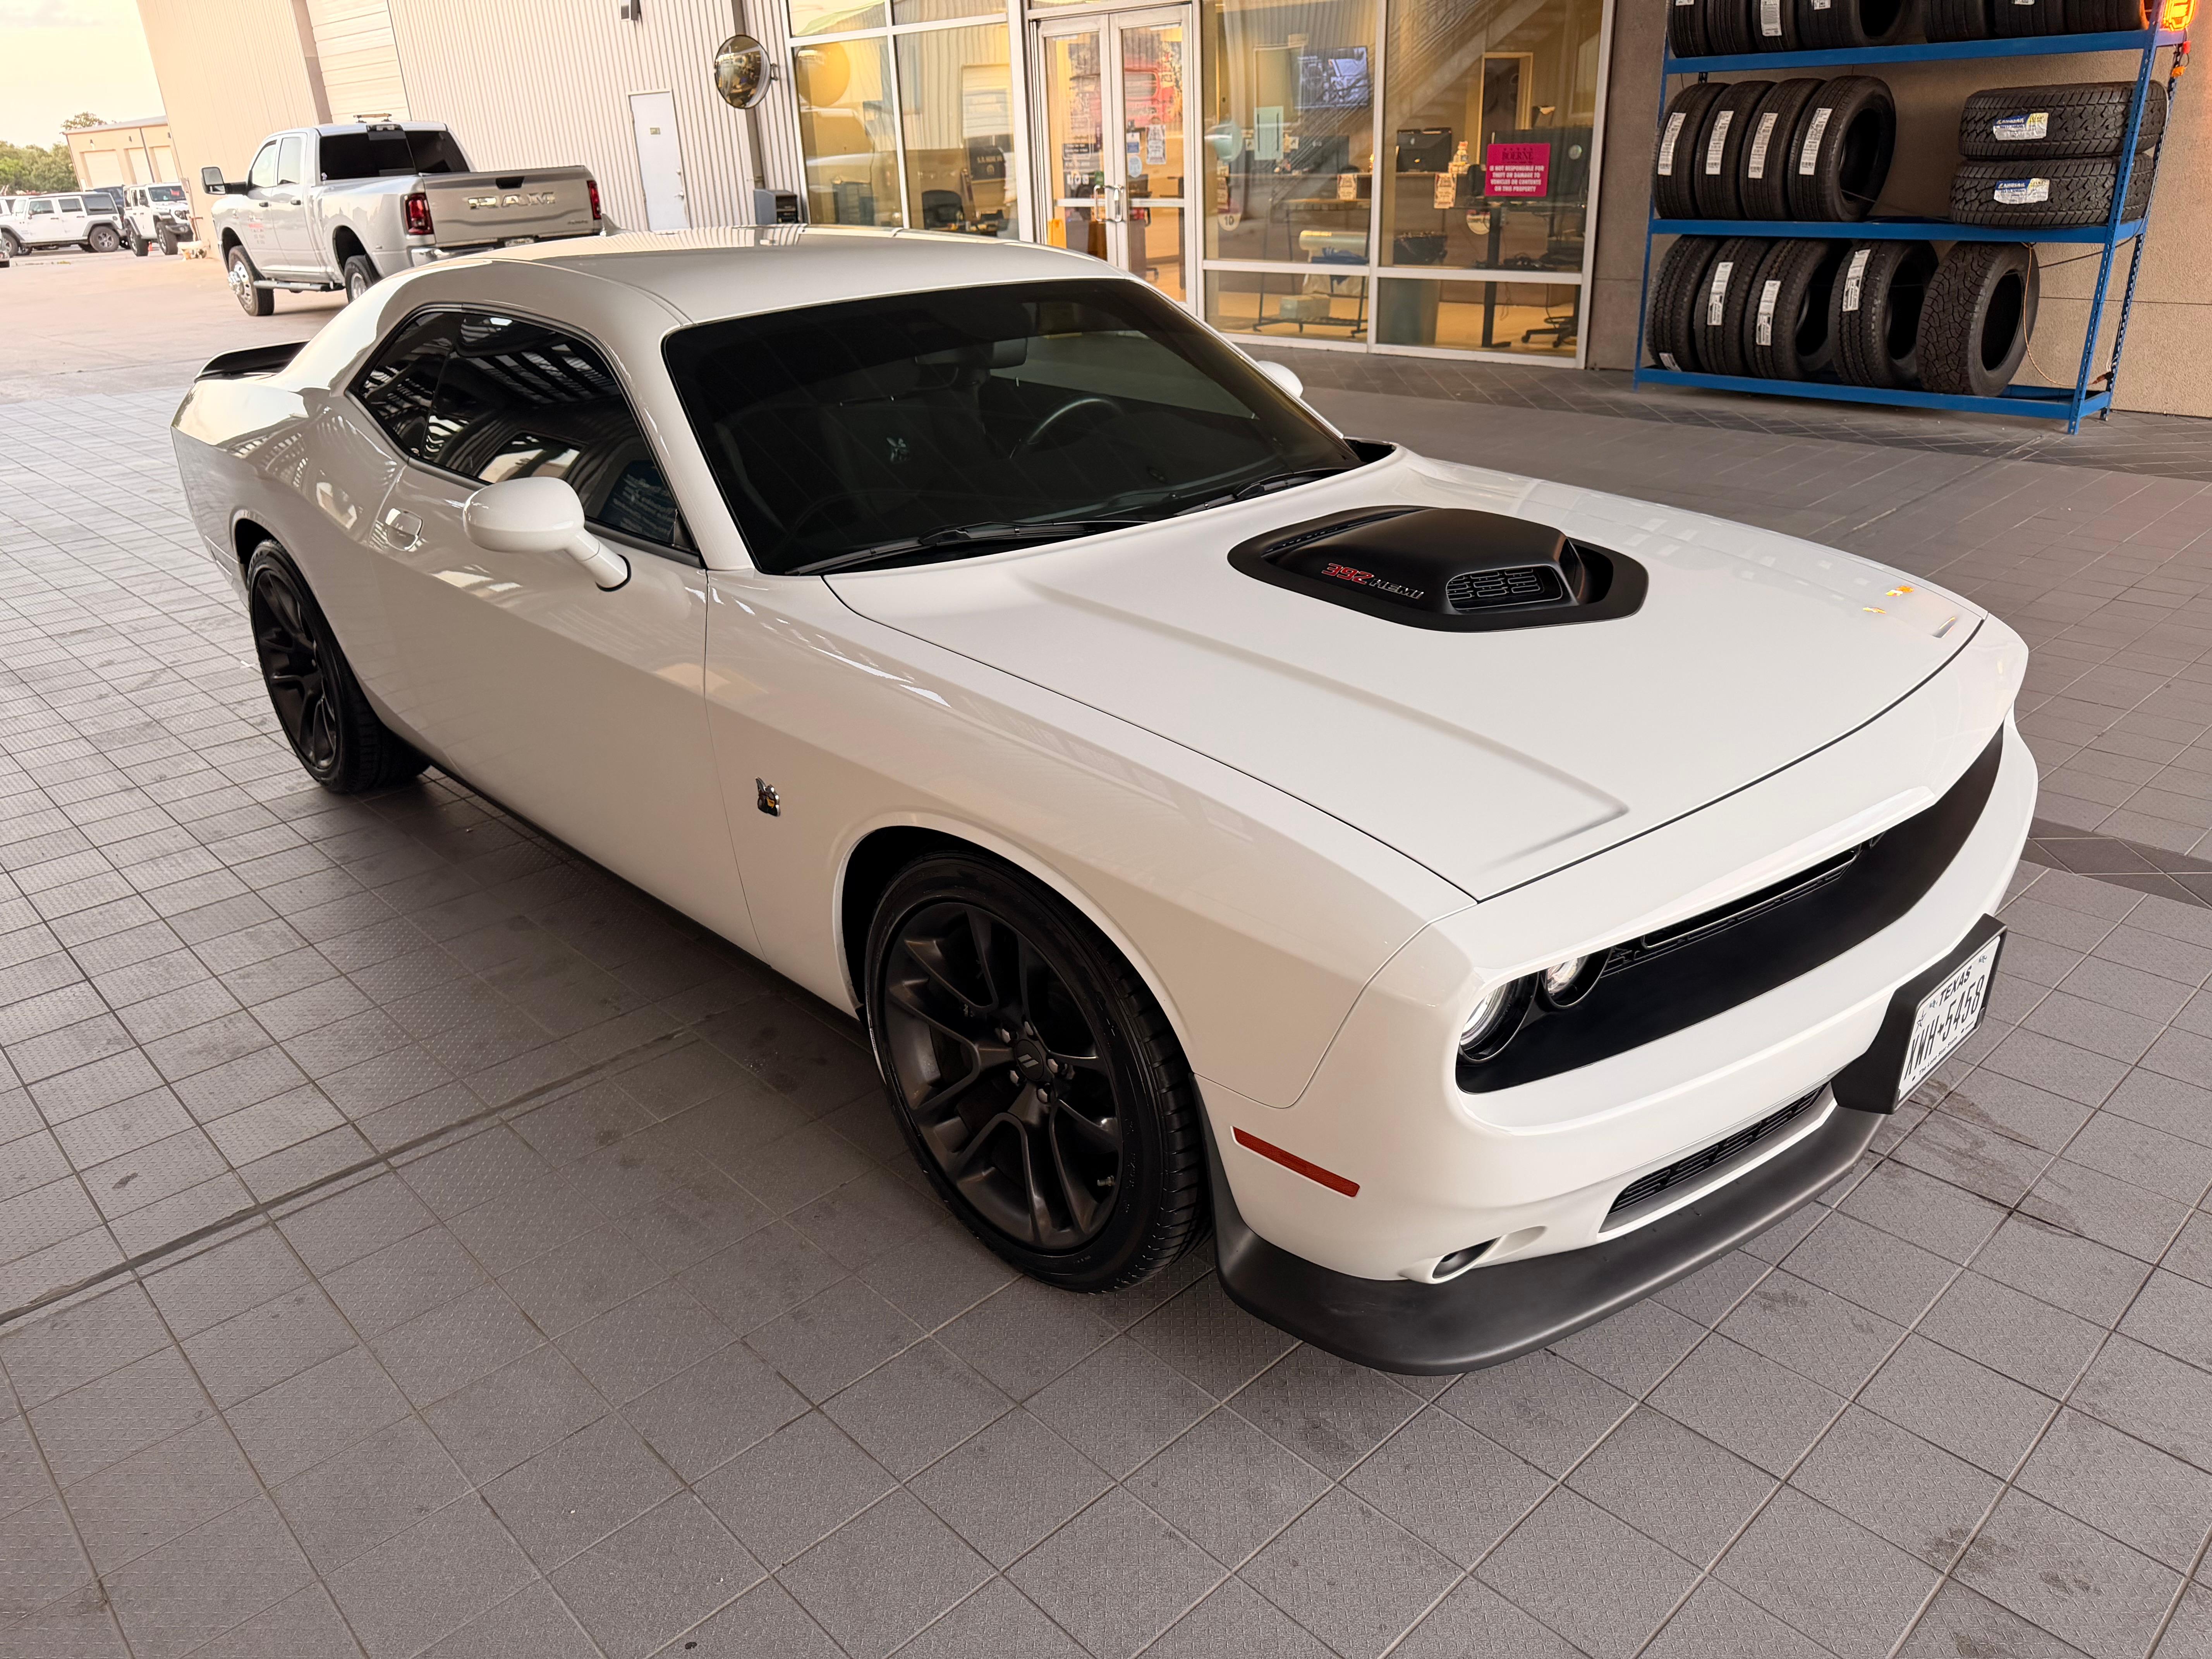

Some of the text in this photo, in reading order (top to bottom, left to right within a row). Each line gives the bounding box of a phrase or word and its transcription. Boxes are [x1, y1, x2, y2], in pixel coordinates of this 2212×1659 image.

[468, 192, 556, 210] RAM
[1321, 563, 1424, 600] 392 HEMI
[1939, 965, 1972, 1006] TEXAS
[1927, 1055, 1937, 1067] Lone
[1938, 1046, 1947, 1056] Star
